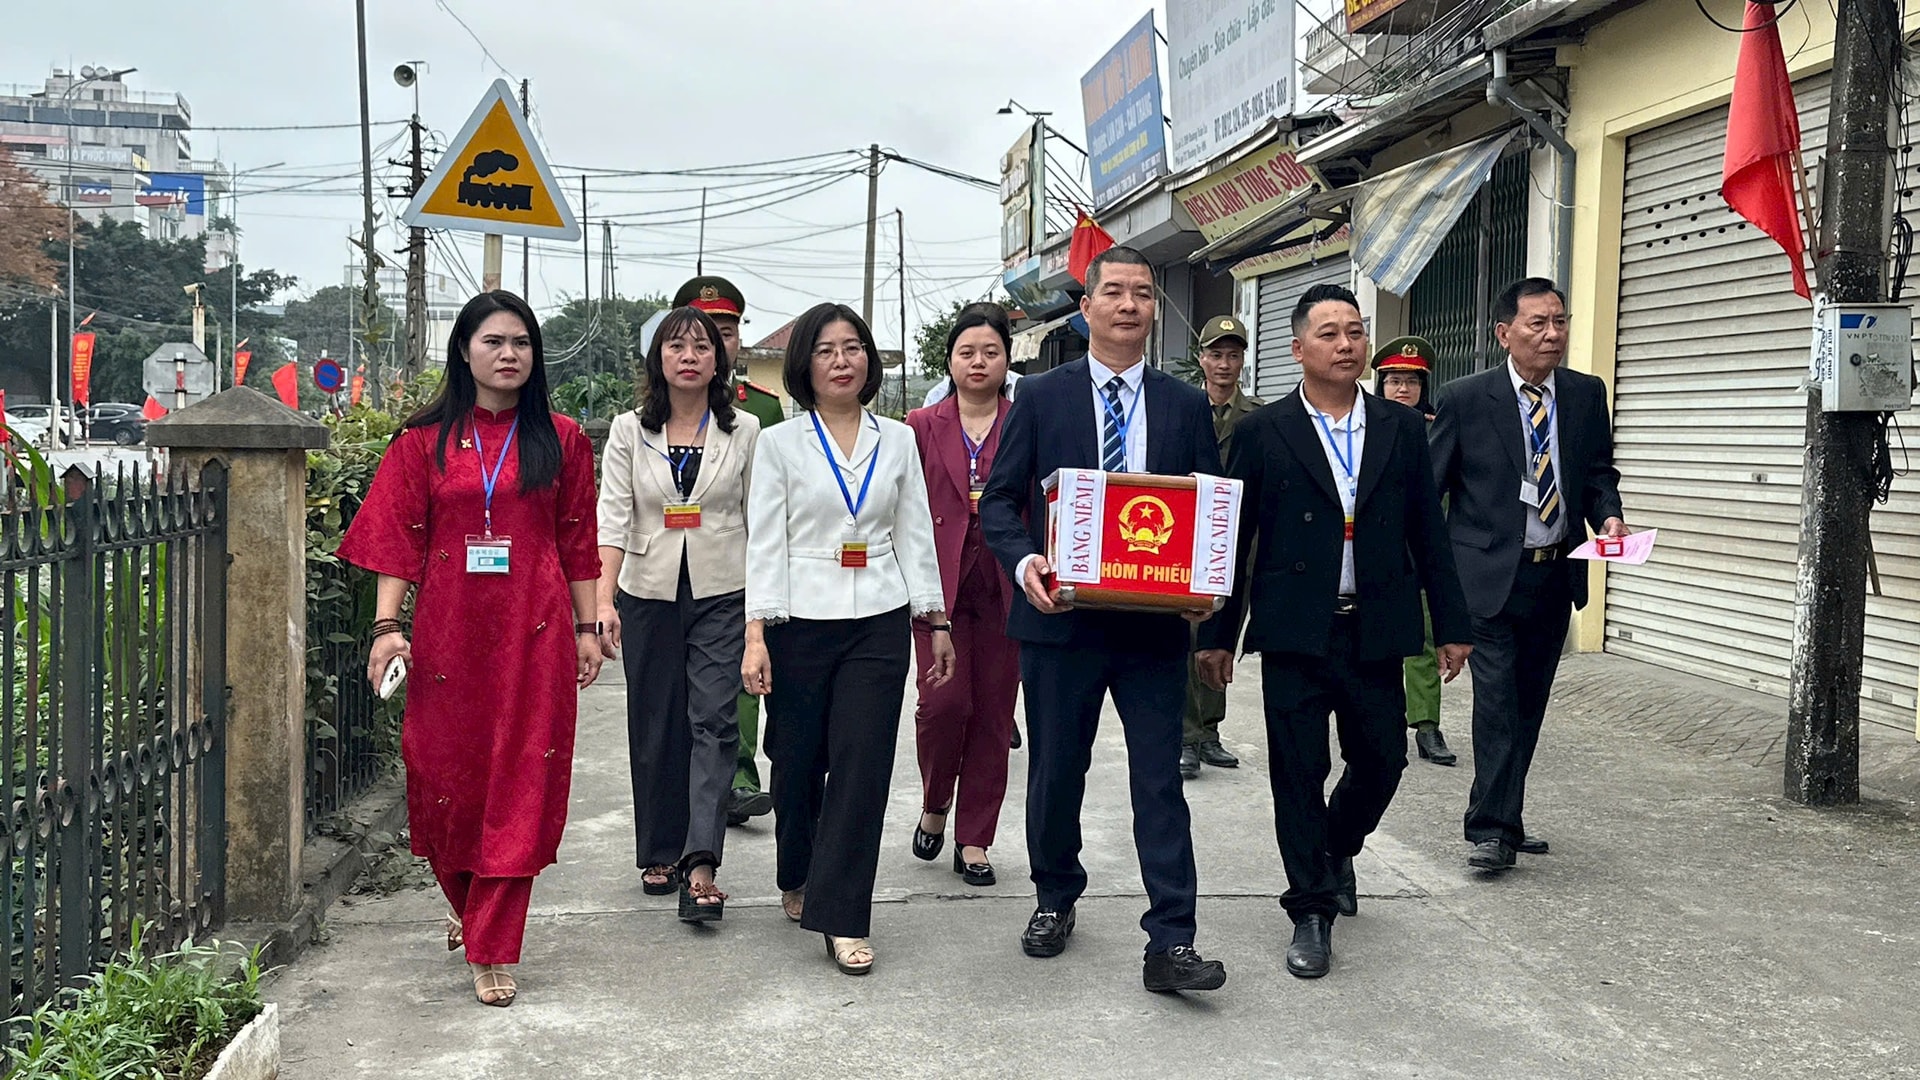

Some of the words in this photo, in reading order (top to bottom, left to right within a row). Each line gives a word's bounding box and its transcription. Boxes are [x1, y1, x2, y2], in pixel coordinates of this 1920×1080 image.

[1182, 189, 1220, 228] ĐIỆN
[1205, 179, 1249, 220] LẠNH
[1233, 164, 1282, 204] TÙNG
[1265, 150, 1313, 191] SƠN
[1070, 486, 1094, 530] NIÊM
[1207, 499, 1230, 543] NIÊM
[1067, 530, 1091, 574] BĂNG
[1101, 558, 1138, 580] HÒM
[1142, 562, 1191, 584] PHIẾU
[1204, 542, 1228, 586] BĂNG
